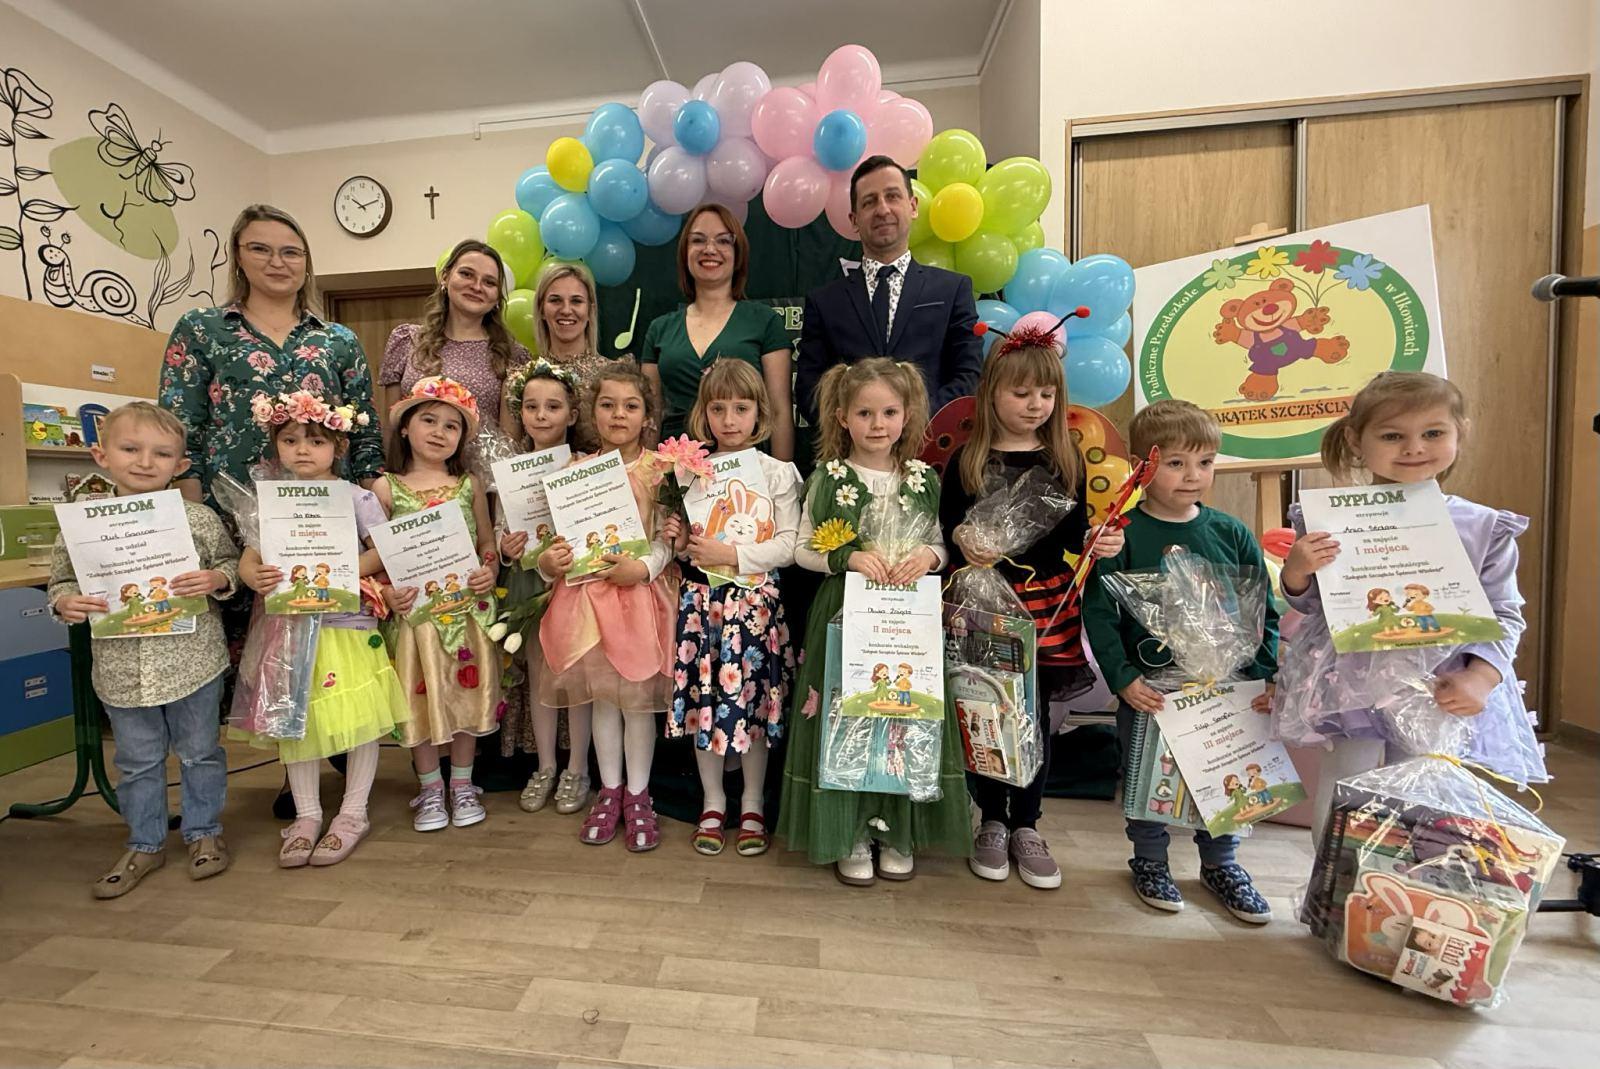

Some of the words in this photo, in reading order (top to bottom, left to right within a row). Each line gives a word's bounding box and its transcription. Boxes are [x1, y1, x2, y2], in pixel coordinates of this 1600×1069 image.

[1149, 288, 1199, 345] Przedszkole
[1385, 283, 1397, 293] w
[1392, 291, 1420, 356] Ilkowicach
[1145, 346, 1163, 398] Publiczne
[1271, 400, 1350, 418] SZCZĘŚCIA
[511, 454, 554, 473] DYPLOM
[546, 457, 620, 490] WYRÓŻNIENIE
[277, 487, 329, 497] DYPLOM
[1328, 490, 1406, 508] DYPLOM
[84, 499, 155, 518] DYPLOM
[390, 511, 442, 535] DYPLOM
[299, 530, 328, 539] miejsca
[1364, 544, 1409, 558] miejsca
[865, 579, 918, 592] DYPLOM
[882, 626, 912, 636] miejsca
[1203, 741, 1212, 750] III
[1215, 728, 1245, 745] miejsca
